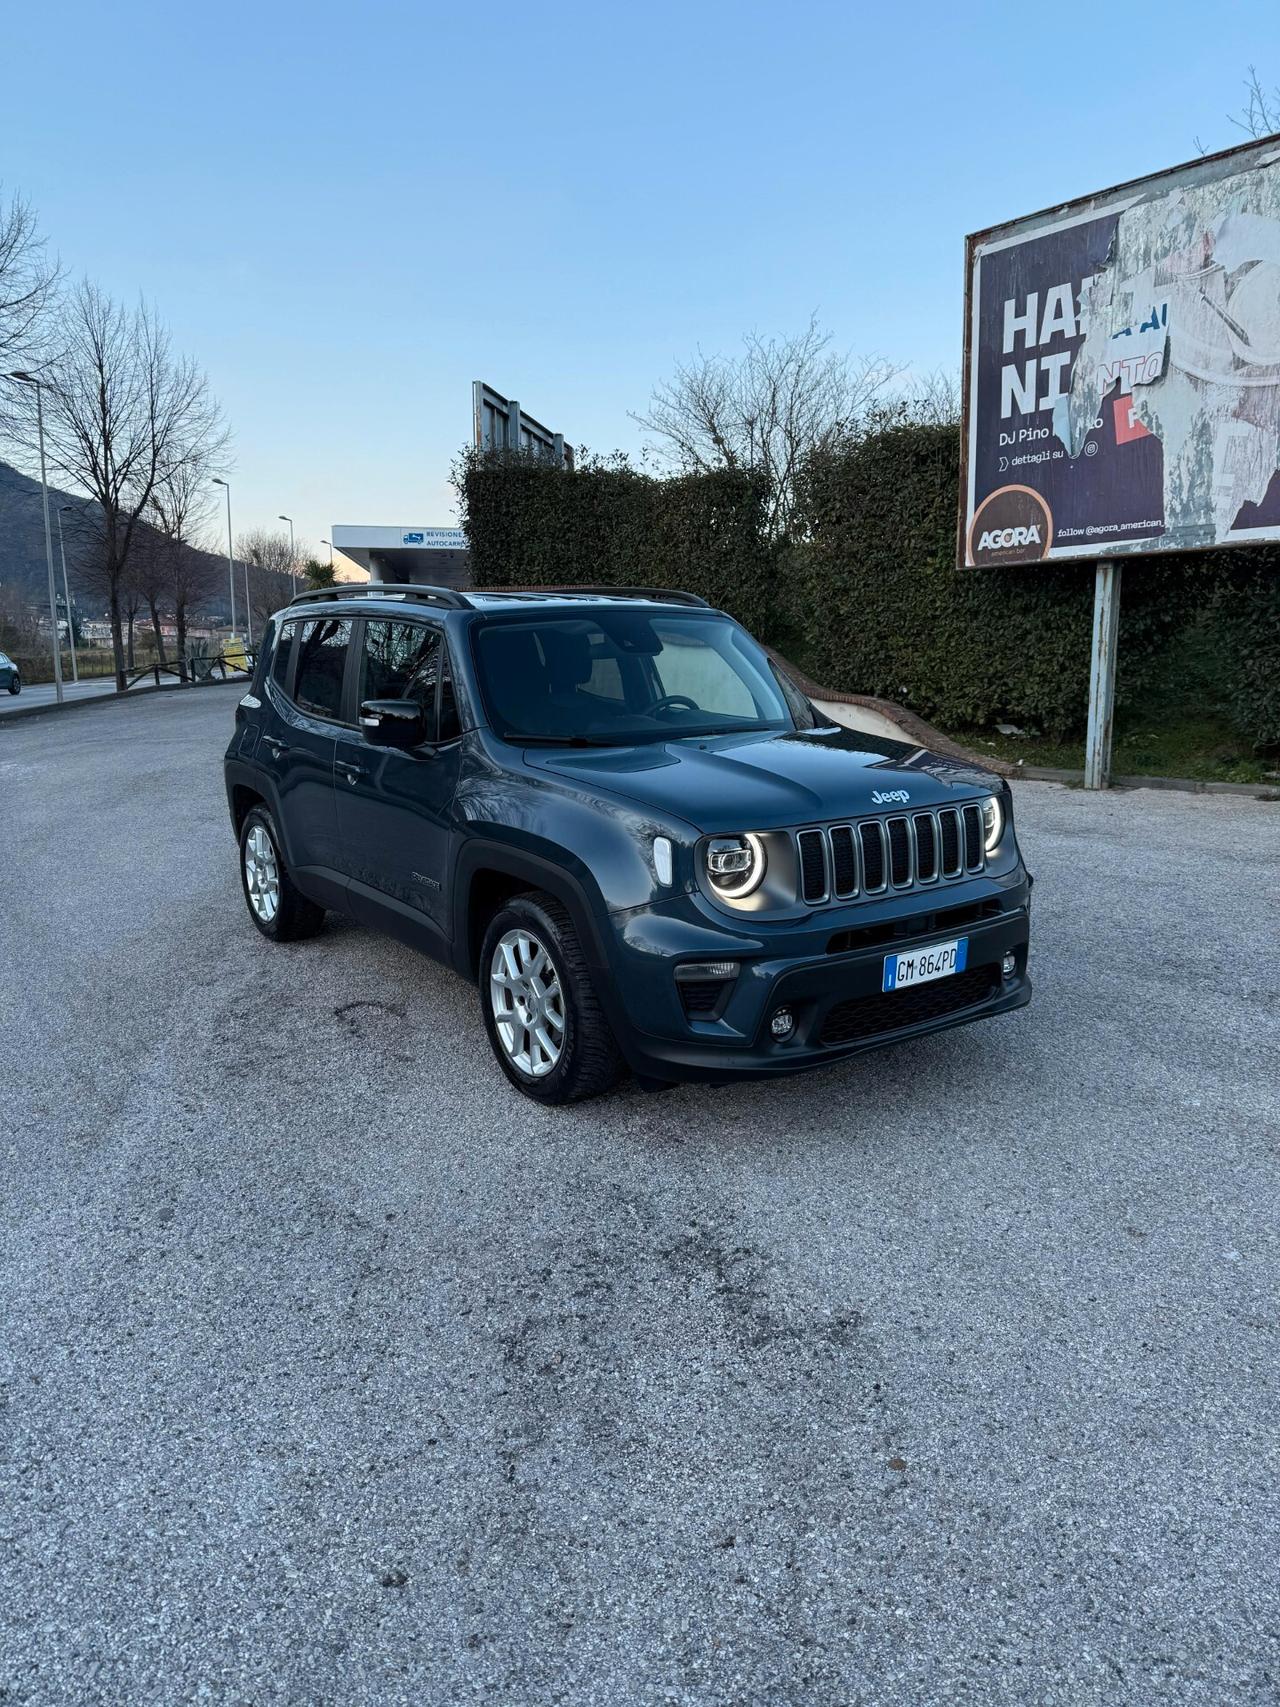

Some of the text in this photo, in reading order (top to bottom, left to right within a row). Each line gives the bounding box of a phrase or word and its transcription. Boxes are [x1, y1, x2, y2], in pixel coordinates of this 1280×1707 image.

[999, 431, 1016, 446] DJ
[1018, 427, 1049, 443] Pino
[1011, 450, 1064, 466] dettagli su
[1057, 528, 1085, 537] follow
[872, 789, 910, 804] Jeep
